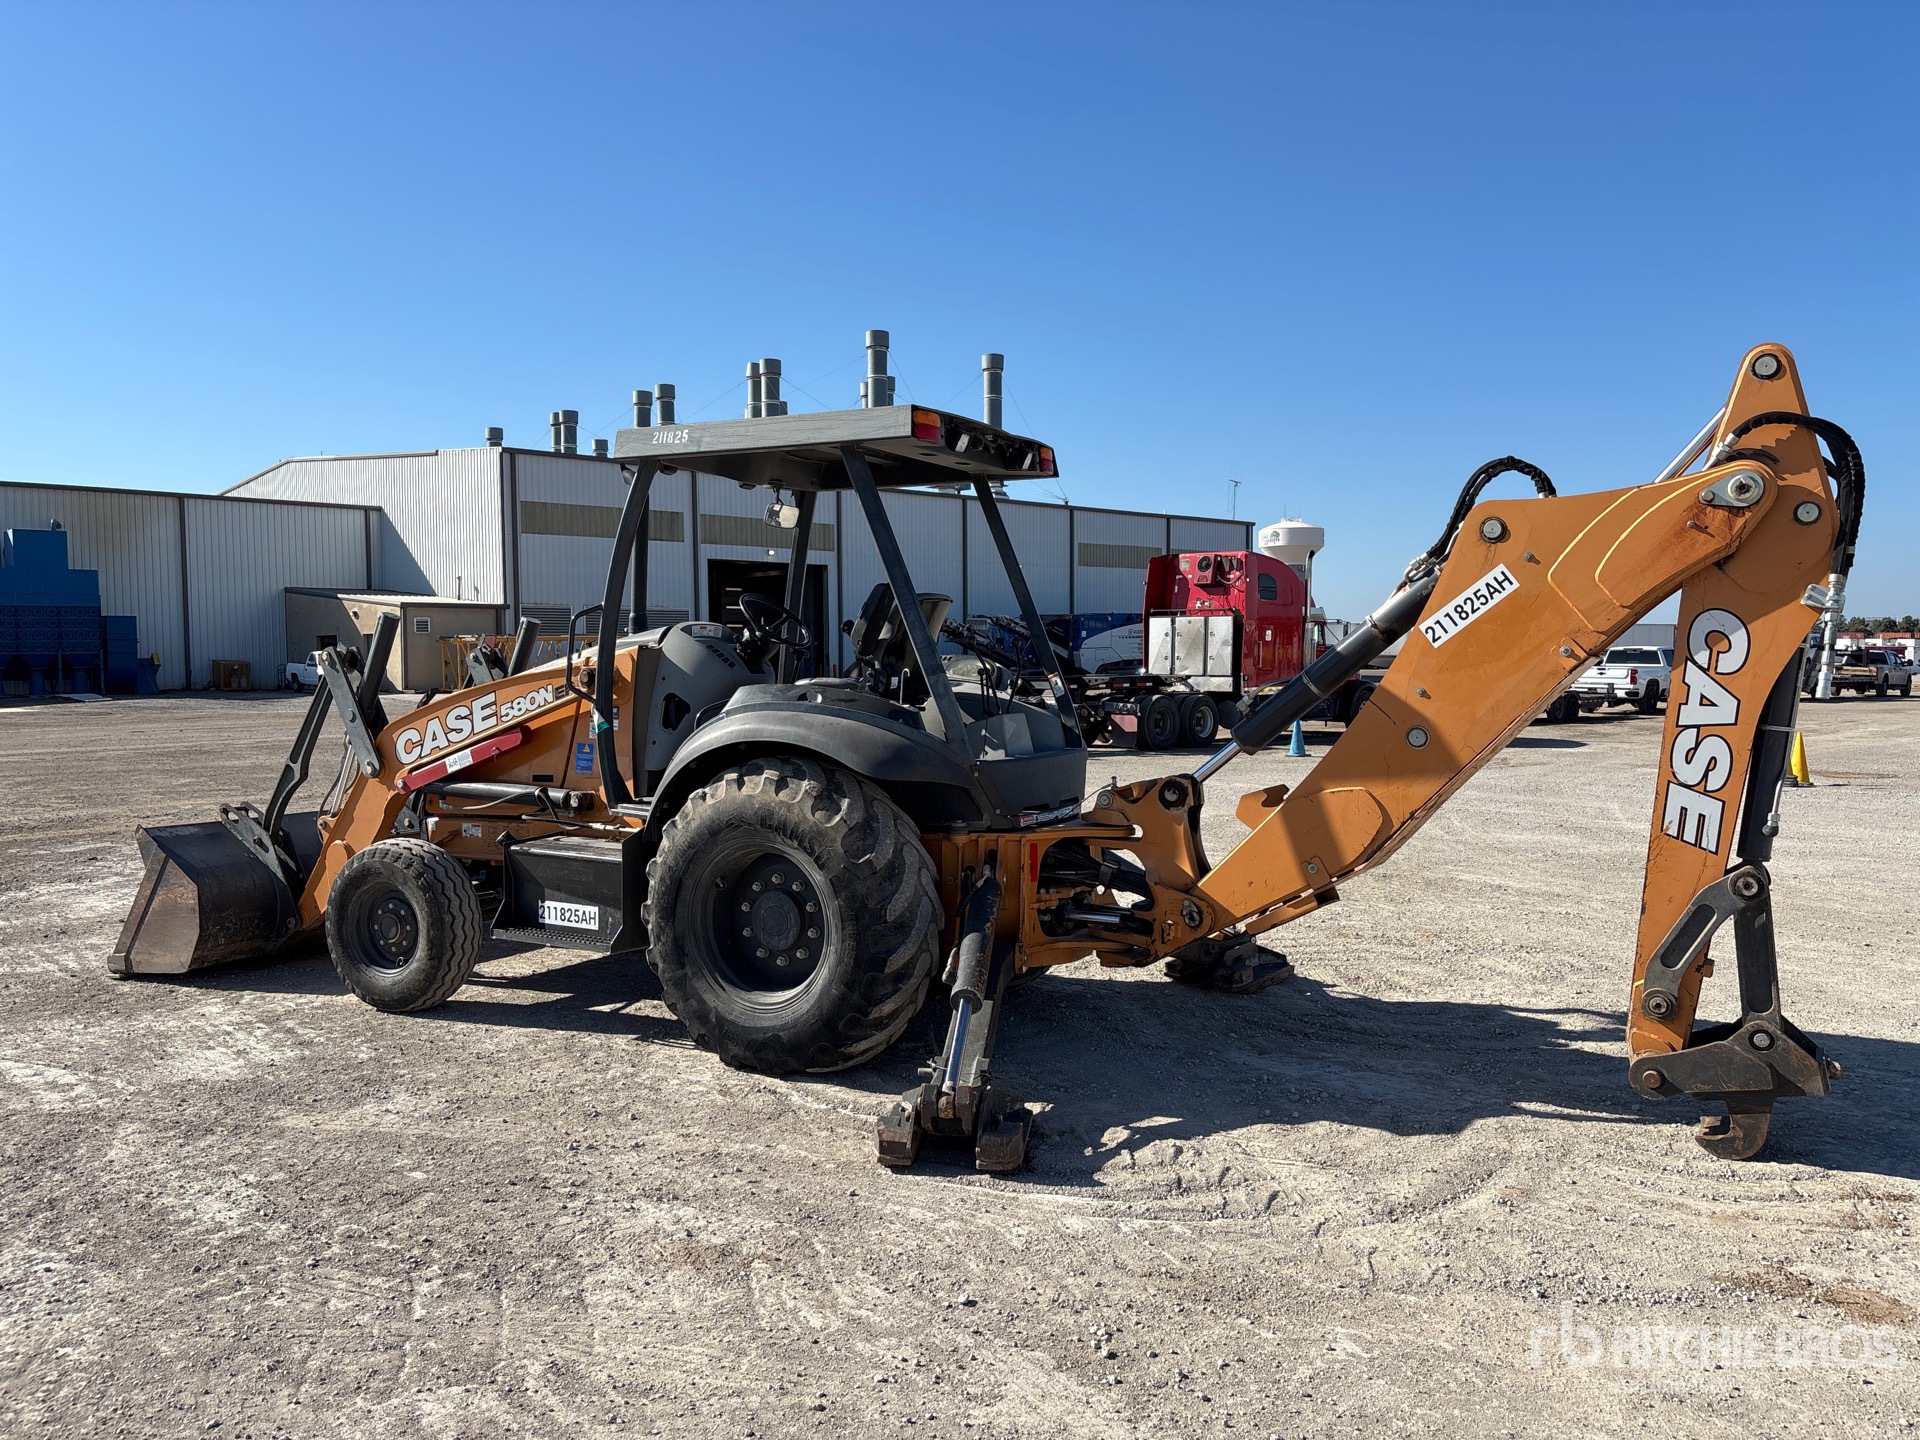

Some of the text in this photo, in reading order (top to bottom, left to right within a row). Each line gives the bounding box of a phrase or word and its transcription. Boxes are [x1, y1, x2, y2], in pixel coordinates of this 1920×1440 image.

[652, 429, 689, 444] 211825
[1424, 570, 1514, 644] 211825AH
[395, 690, 499, 765] CASE
[500, 683, 554, 723] 580N
[1660, 607, 1752, 856] CASE
[539, 904, 597, 926] 211825AH
